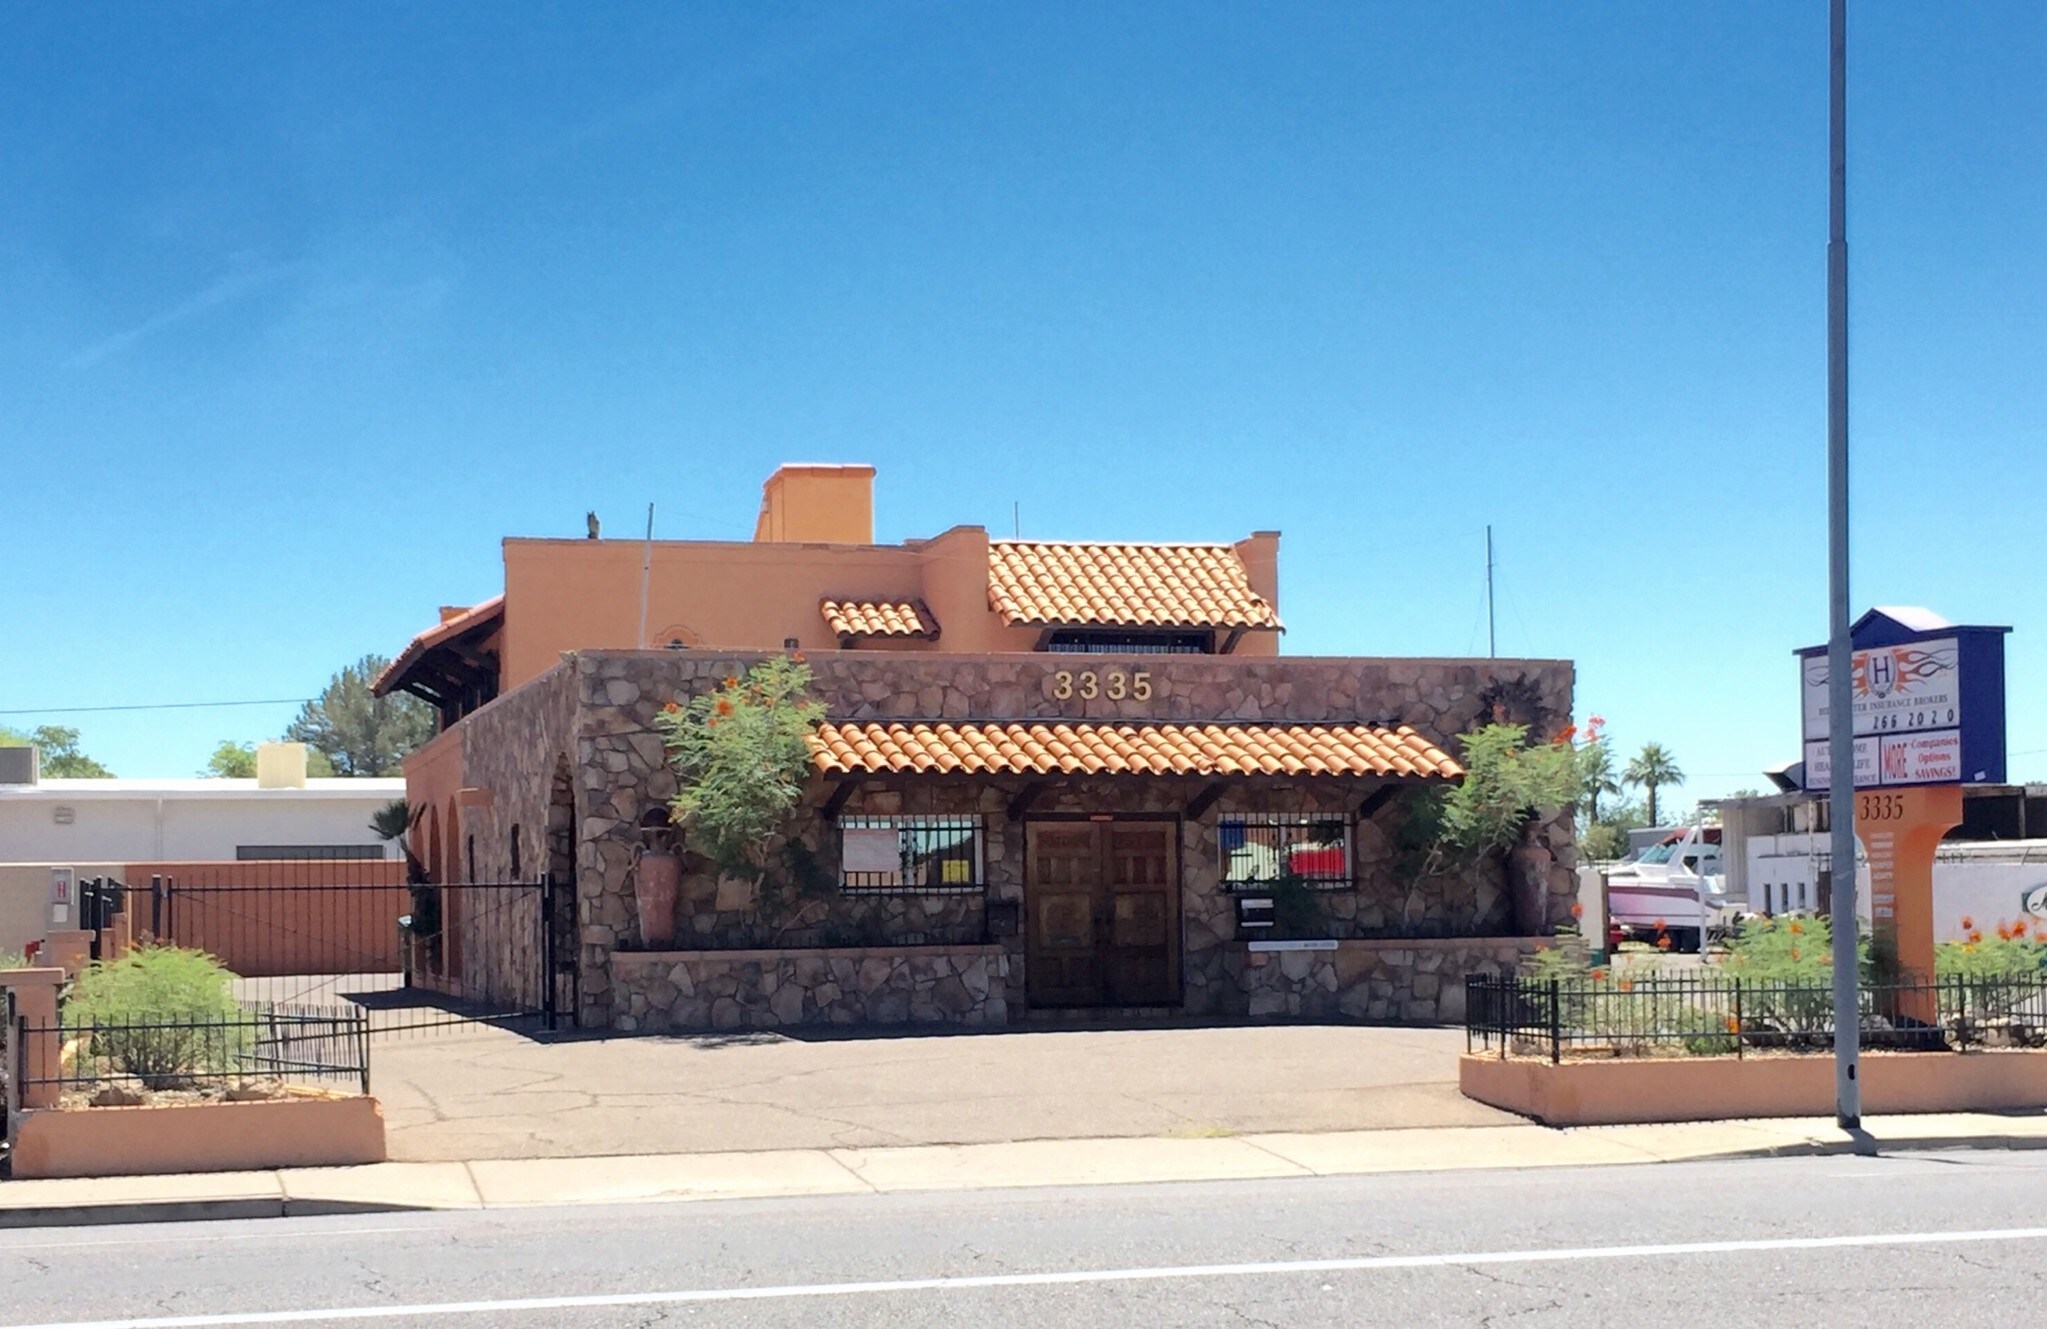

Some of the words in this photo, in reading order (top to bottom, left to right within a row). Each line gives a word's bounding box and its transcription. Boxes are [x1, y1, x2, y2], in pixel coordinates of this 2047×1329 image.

[1872, 655, 1890, 685] H
[1054, 671, 1152, 701] 3335
[1869, 698, 1911, 710] INSURANCE
[1914, 694, 1948, 706] BROKERS
[1873, 714, 1897, 730] 266
[1911, 738, 1958, 749] Companies
[1884, 742, 1908, 779] MORE
[1918, 753, 1951, 764] Options
[1915, 767, 1956, 779] SAVINGS!
[1860, 795, 1904, 820] 3335
